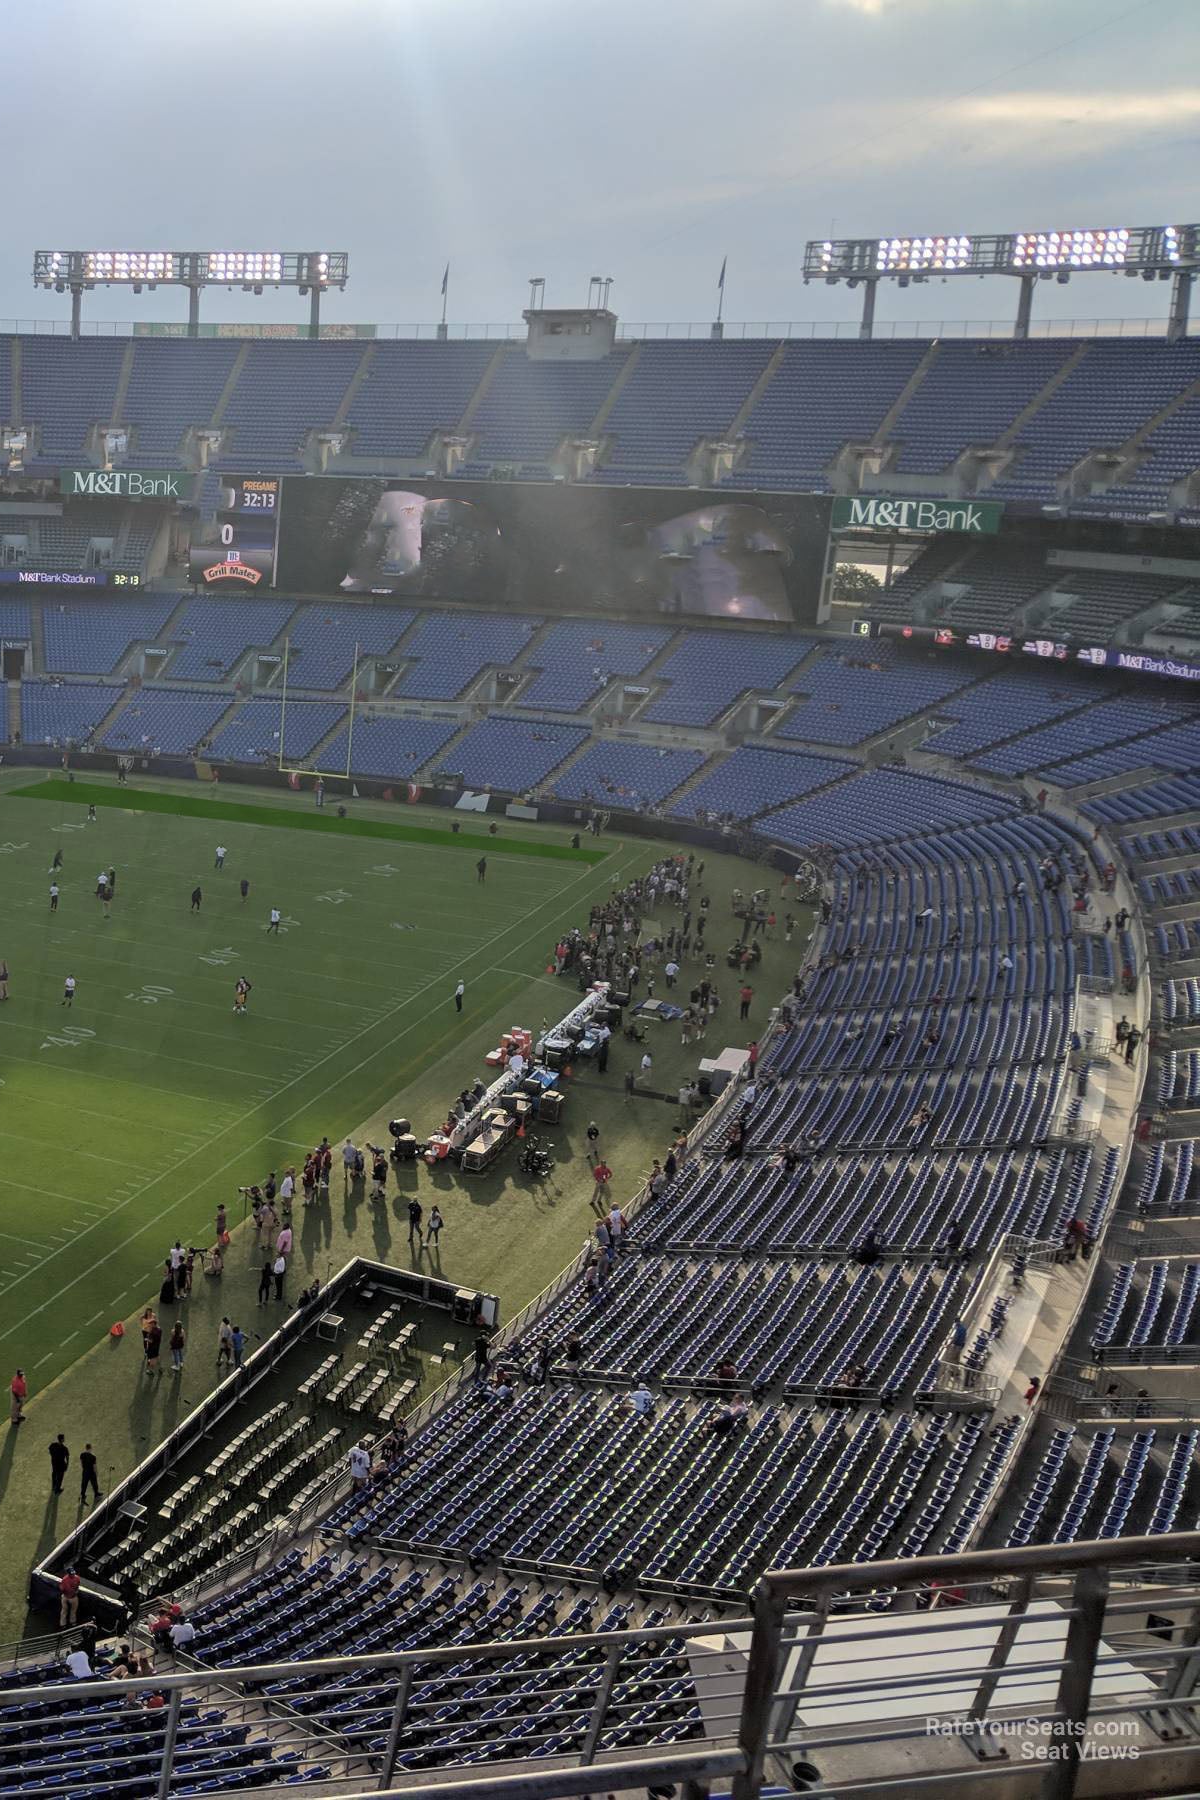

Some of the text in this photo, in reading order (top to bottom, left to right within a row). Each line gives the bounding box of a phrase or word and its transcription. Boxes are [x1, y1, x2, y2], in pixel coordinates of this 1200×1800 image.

[73, 471, 179, 496] M&T Bank
[243, 481, 277, 491] PREGAME
[243, 493, 275, 507] 32:13
[848, 498, 982, 530] M&T Bank
[221, 524, 233, 544] 0
[19, 572, 95, 584] M&T Bank Stadium
[114, 574, 139, 585] 32:13
[208, 566, 257, 580] Grill Mates
[1118, 653, 1145, 669] M&T
[1145, 657, 1166, 672] Bank
[124, 985, 174, 1003] 50
[46, 1026, 97, 1047] 40
